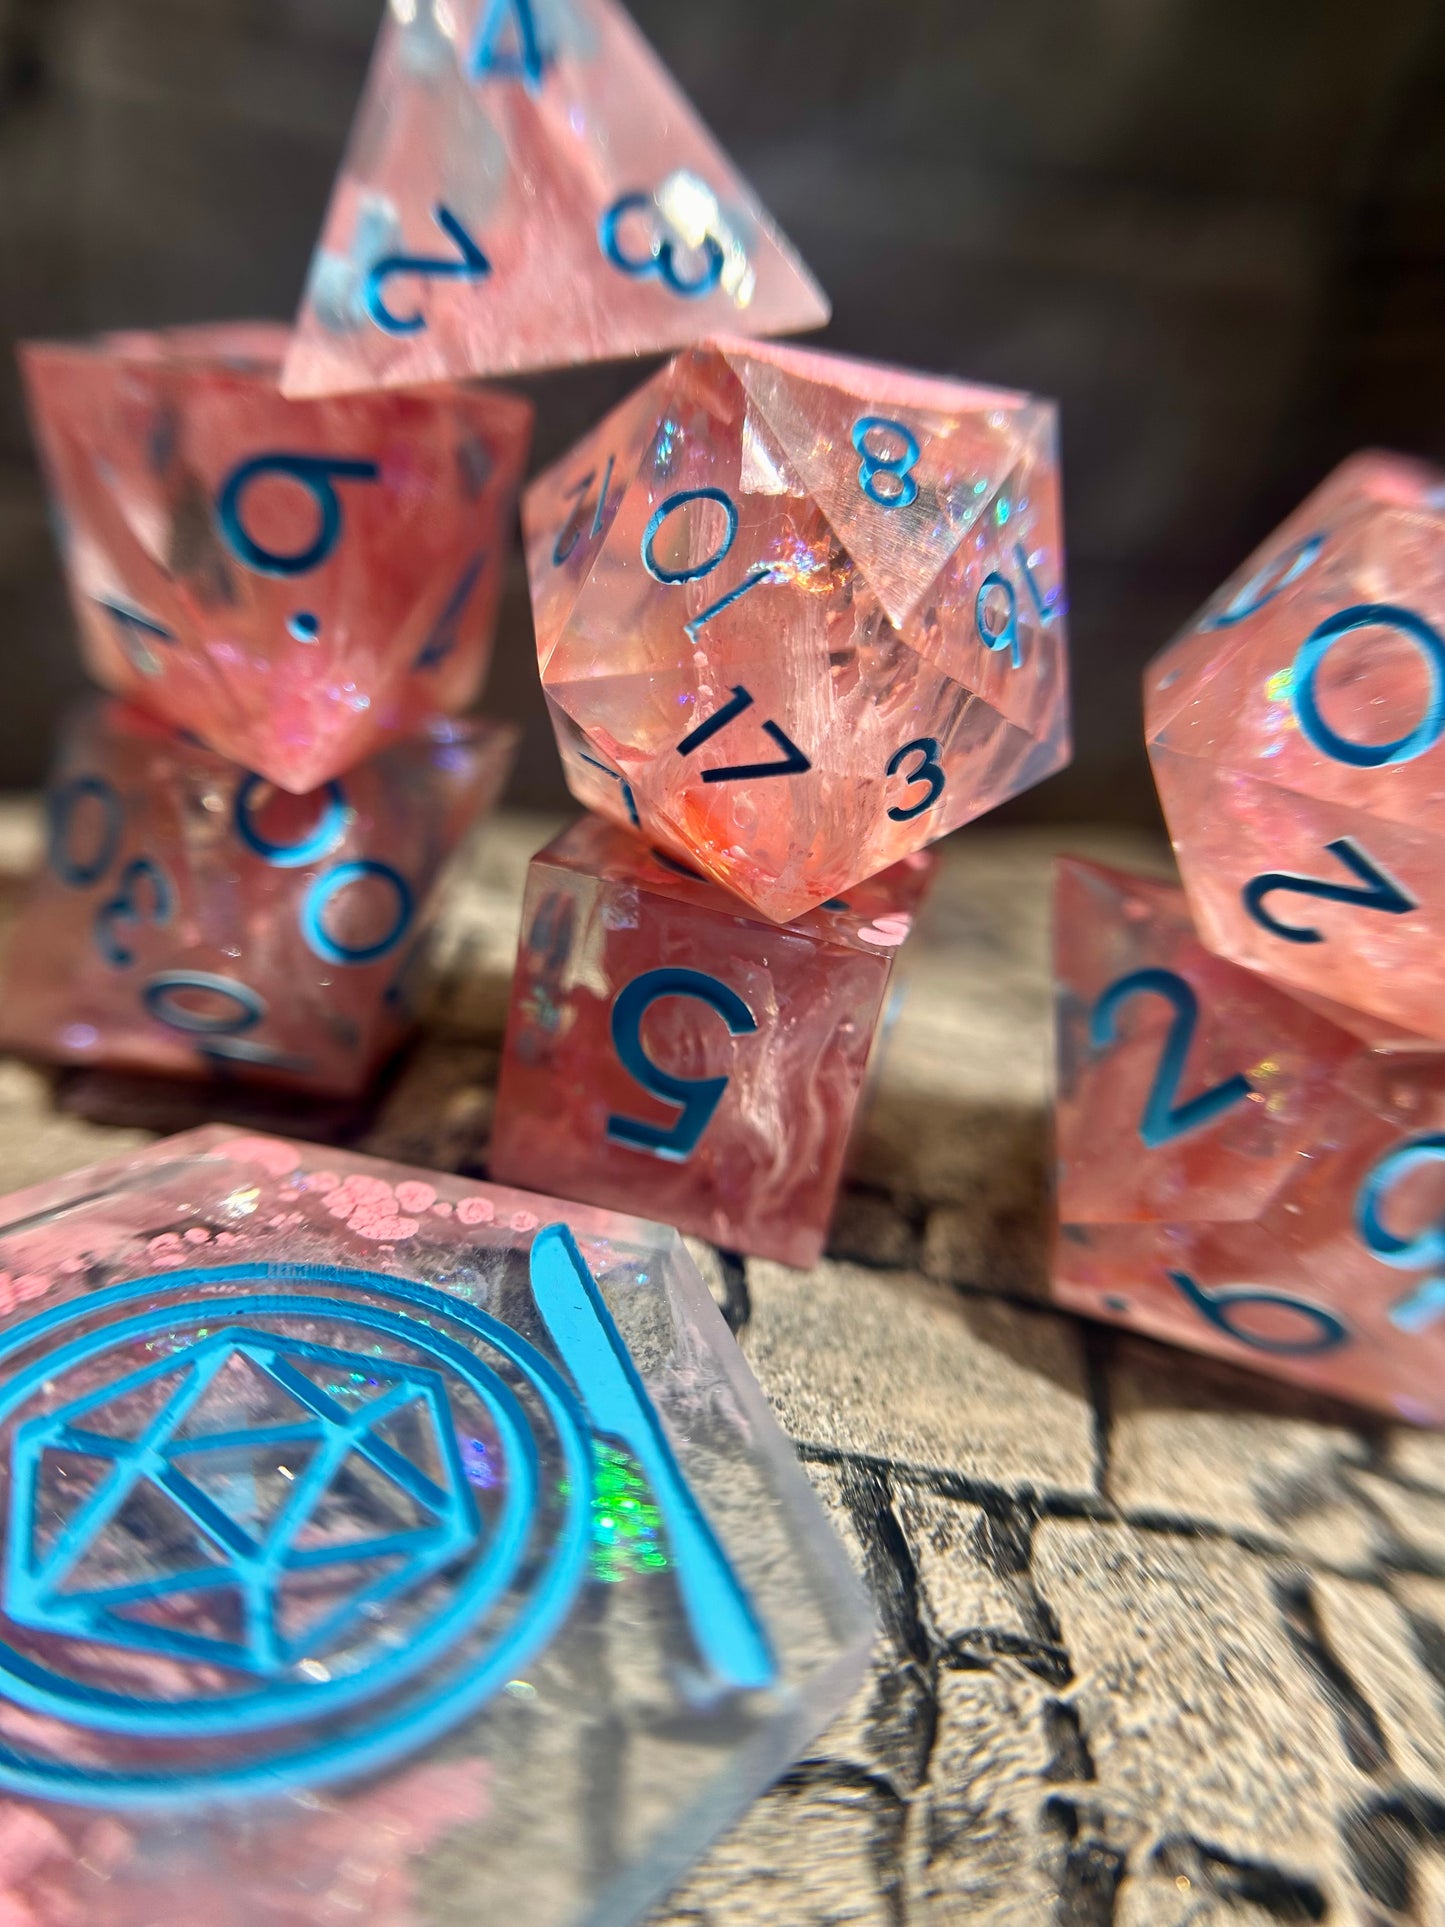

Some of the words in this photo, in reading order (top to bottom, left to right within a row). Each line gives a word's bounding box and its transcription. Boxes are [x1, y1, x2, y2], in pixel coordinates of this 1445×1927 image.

[363, 203, 491, 336] 2
[599, 193, 727, 296] 3
[852, 415, 917, 508] 8
[640, 485, 773, 644] 10
[677, 685, 811, 783] 17
[886, 737, 947, 822] 3
[1242, 835, 1420, 944] 2
[605, 967, 758, 1164] 5
[1090, 968, 1254, 1149] 2
